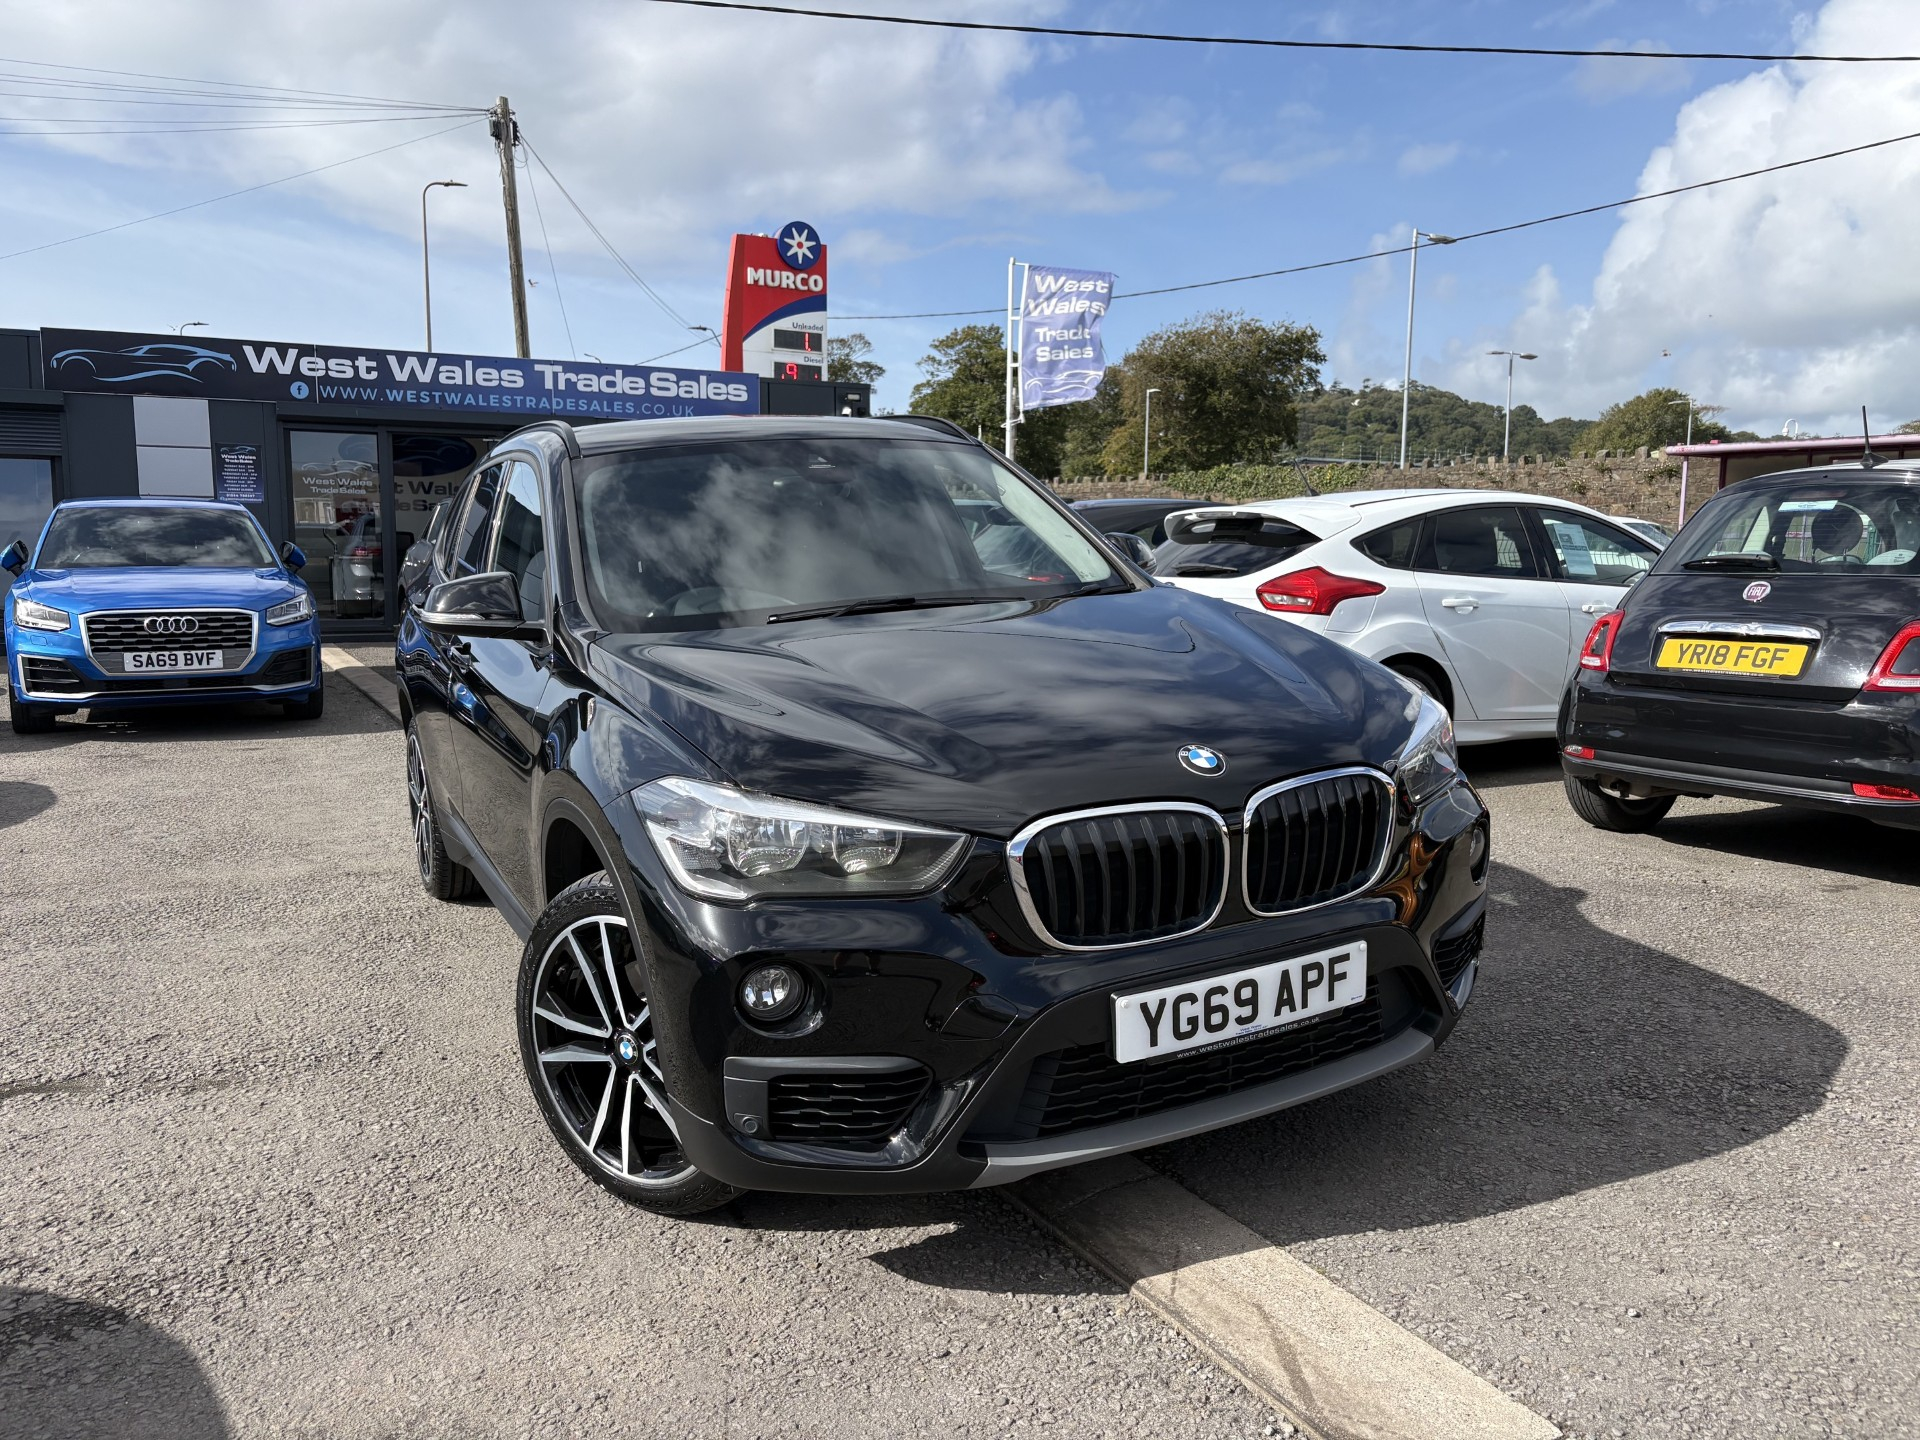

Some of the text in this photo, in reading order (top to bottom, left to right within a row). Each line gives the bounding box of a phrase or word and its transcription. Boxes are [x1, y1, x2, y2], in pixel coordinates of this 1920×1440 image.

[747, 266, 824, 292] MURCO
[1034, 275, 1110, 294] West
[1027, 296, 1106, 317] Wales
[792, 322, 824, 331] Unleaded
[803, 356, 824, 364] Diesel
[1036, 344, 1094, 363] Sales
[241, 344, 748, 402] West Wales Trade Sales
[319, 384, 695, 417] WWW.WESTWALESTRADESALES.CO.UK
[302, 476, 373, 487] West Wales
[1748, 586, 1767, 597] FIAT
[132, 651, 216, 669] SA69 BVF
[1677, 643, 1790, 670] YR18 FGF
[1139, 952, 1351, 1048] YG69 APF
[1176, 1016, 1320, 1059] www.westwalestradesales.co.uk
